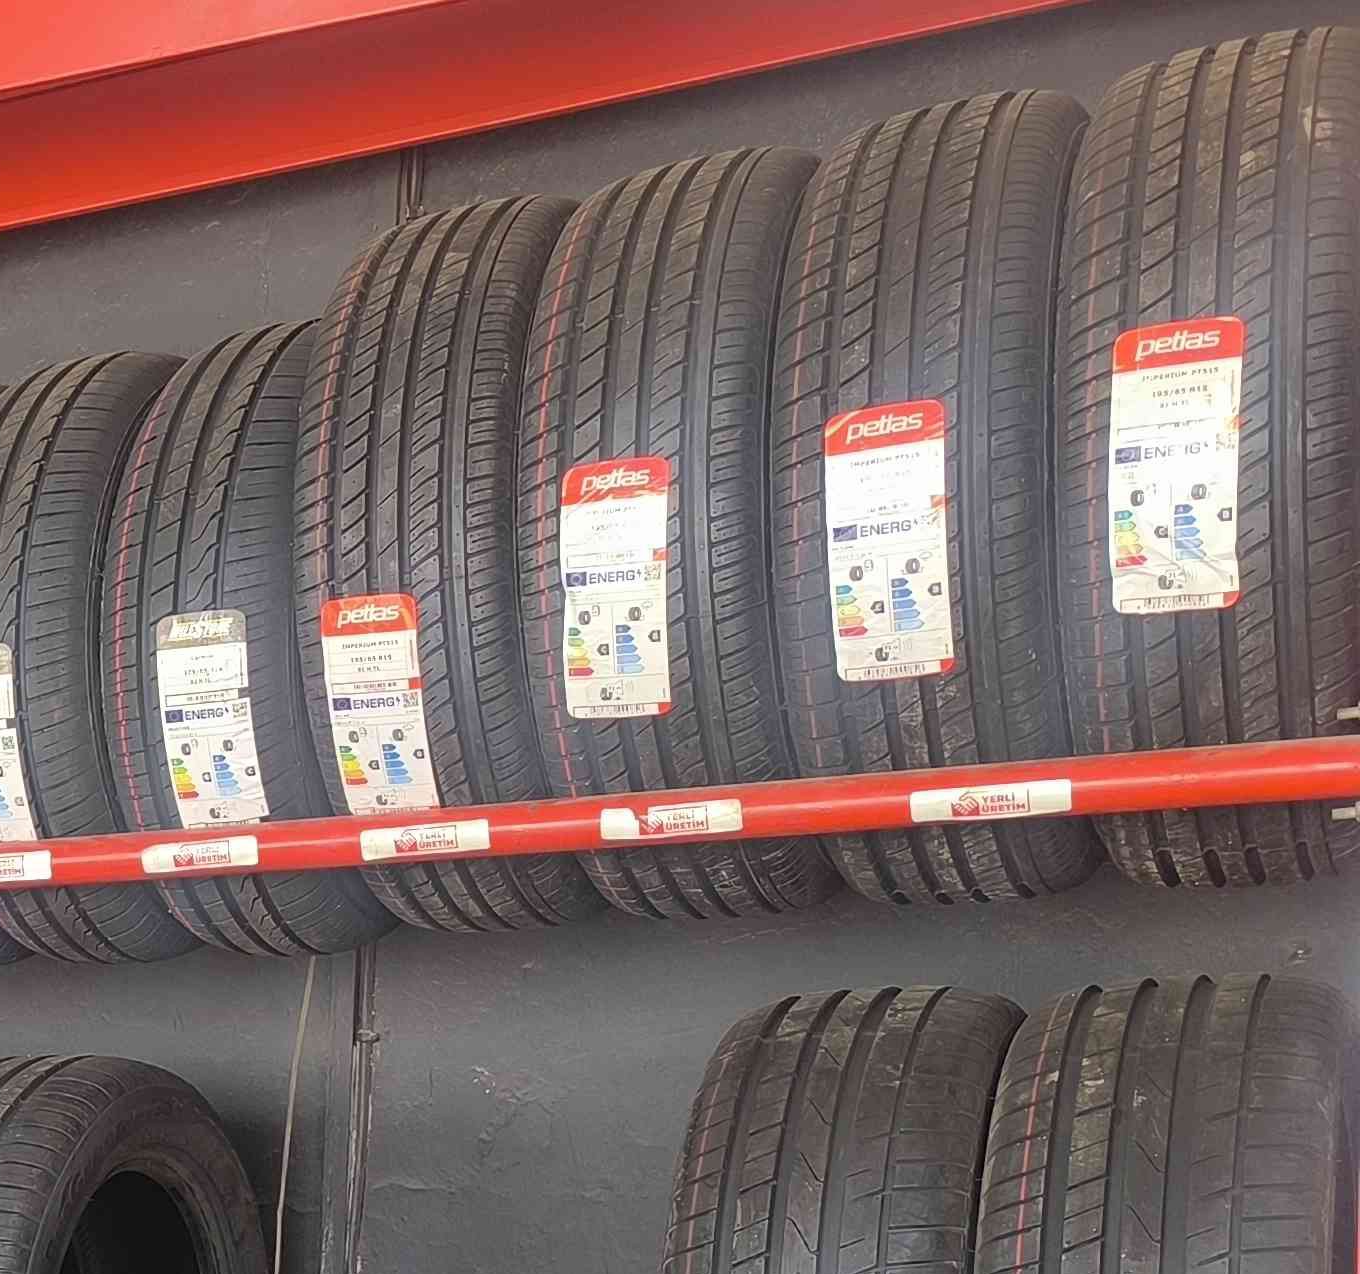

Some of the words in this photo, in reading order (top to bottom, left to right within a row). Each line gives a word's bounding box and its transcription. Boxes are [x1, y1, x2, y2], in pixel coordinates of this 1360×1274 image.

[1135, 329, 1222, 362] petlas
[845, 412, 924, 445] petlas
[580, 467, 651, 497] petlas
[860, 519, 913, 539] ENERG
[589, 572, 637, 586] ENERG
[337, 603, 401, 629] petlas
[184, 707, 224, 721] ENERG
[352, 697, 394, 710] ENERG
